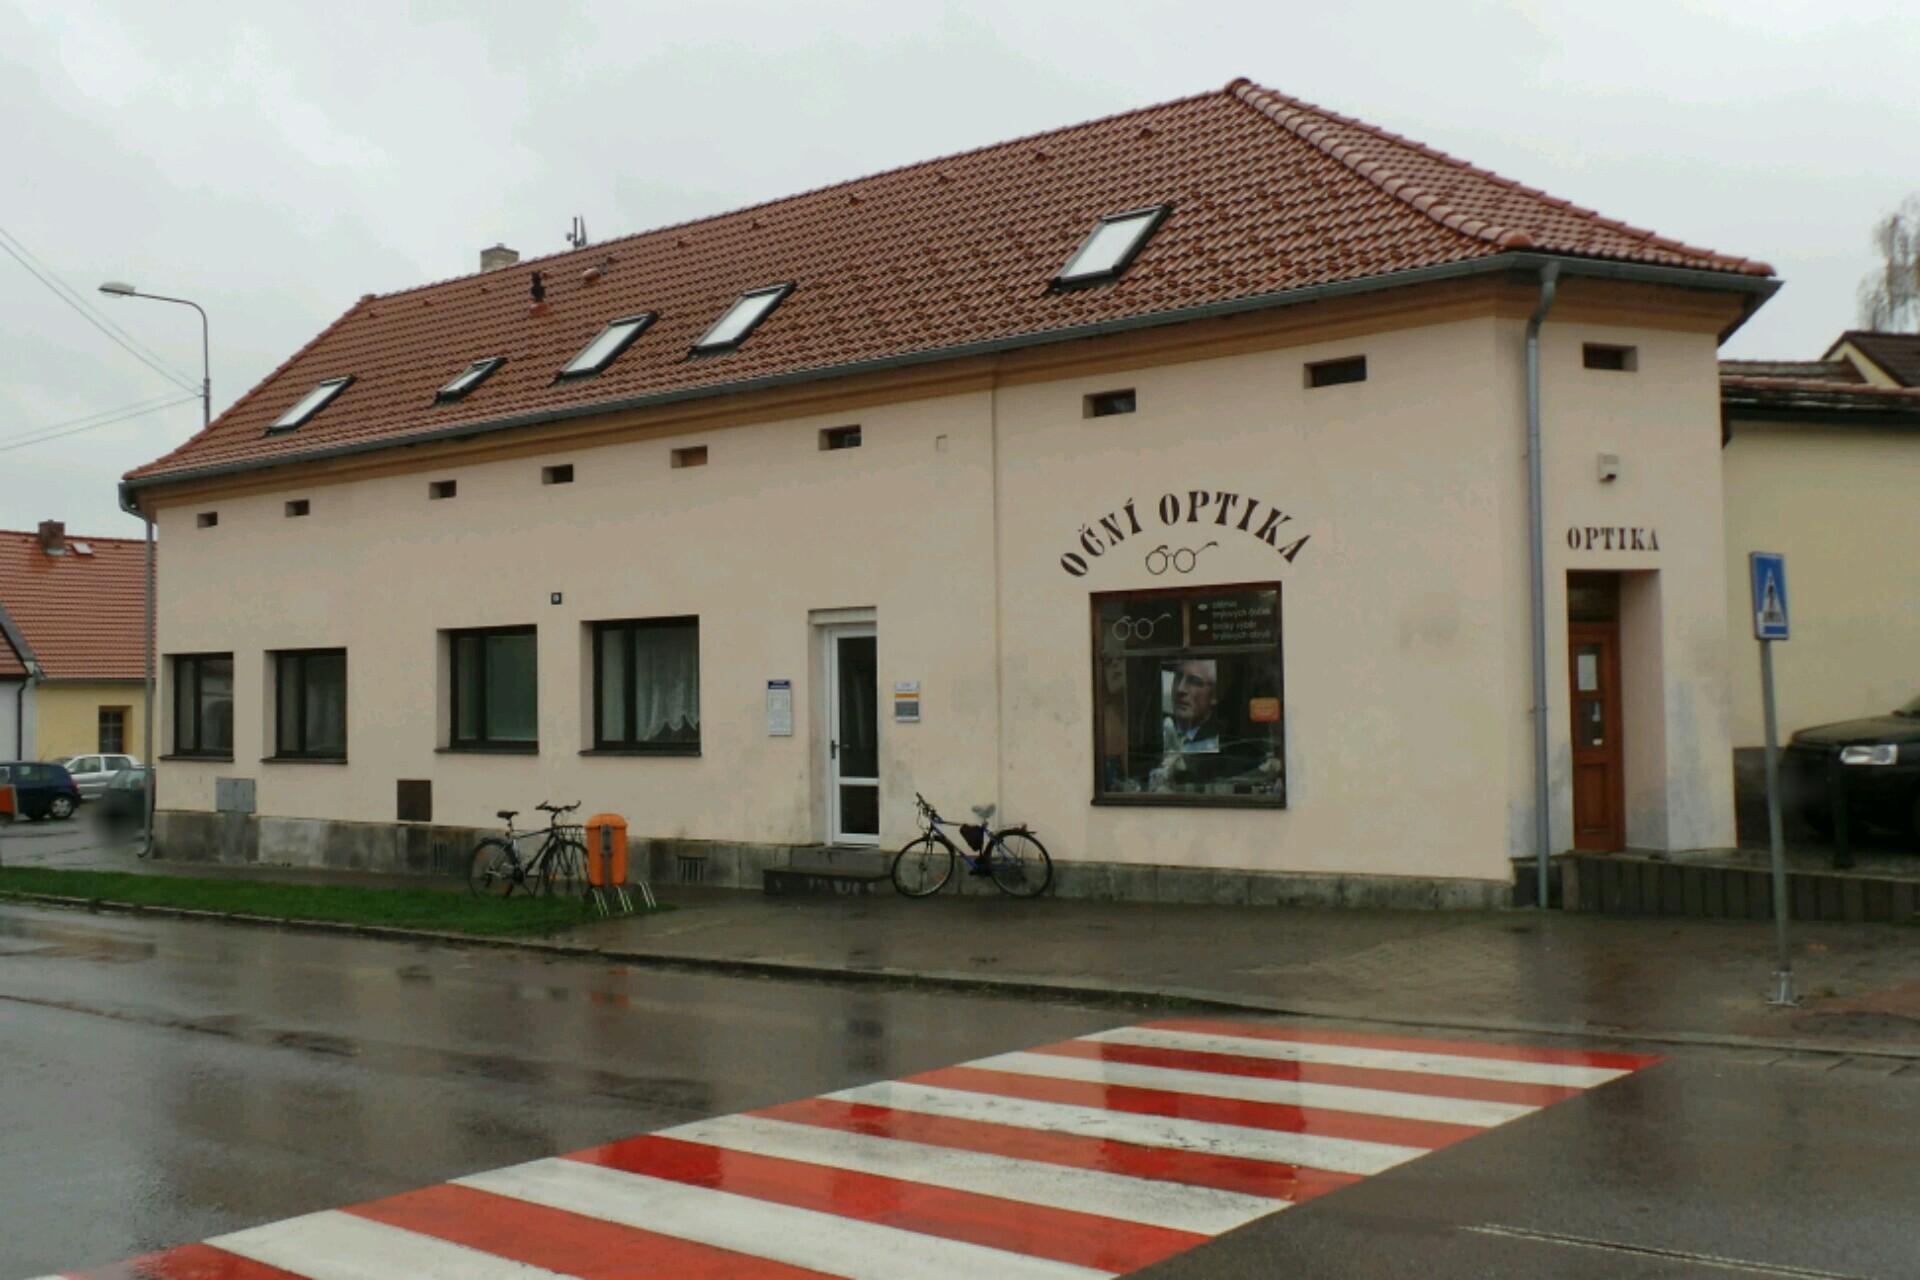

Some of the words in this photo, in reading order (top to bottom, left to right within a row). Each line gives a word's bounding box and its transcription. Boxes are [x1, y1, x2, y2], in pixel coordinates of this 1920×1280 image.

[1061, 498, 1142, 577] OČNÍ
[1158, 491, 1311, 564] OPTIKA
[1567, 527, 1659, 551] OPTIKA
